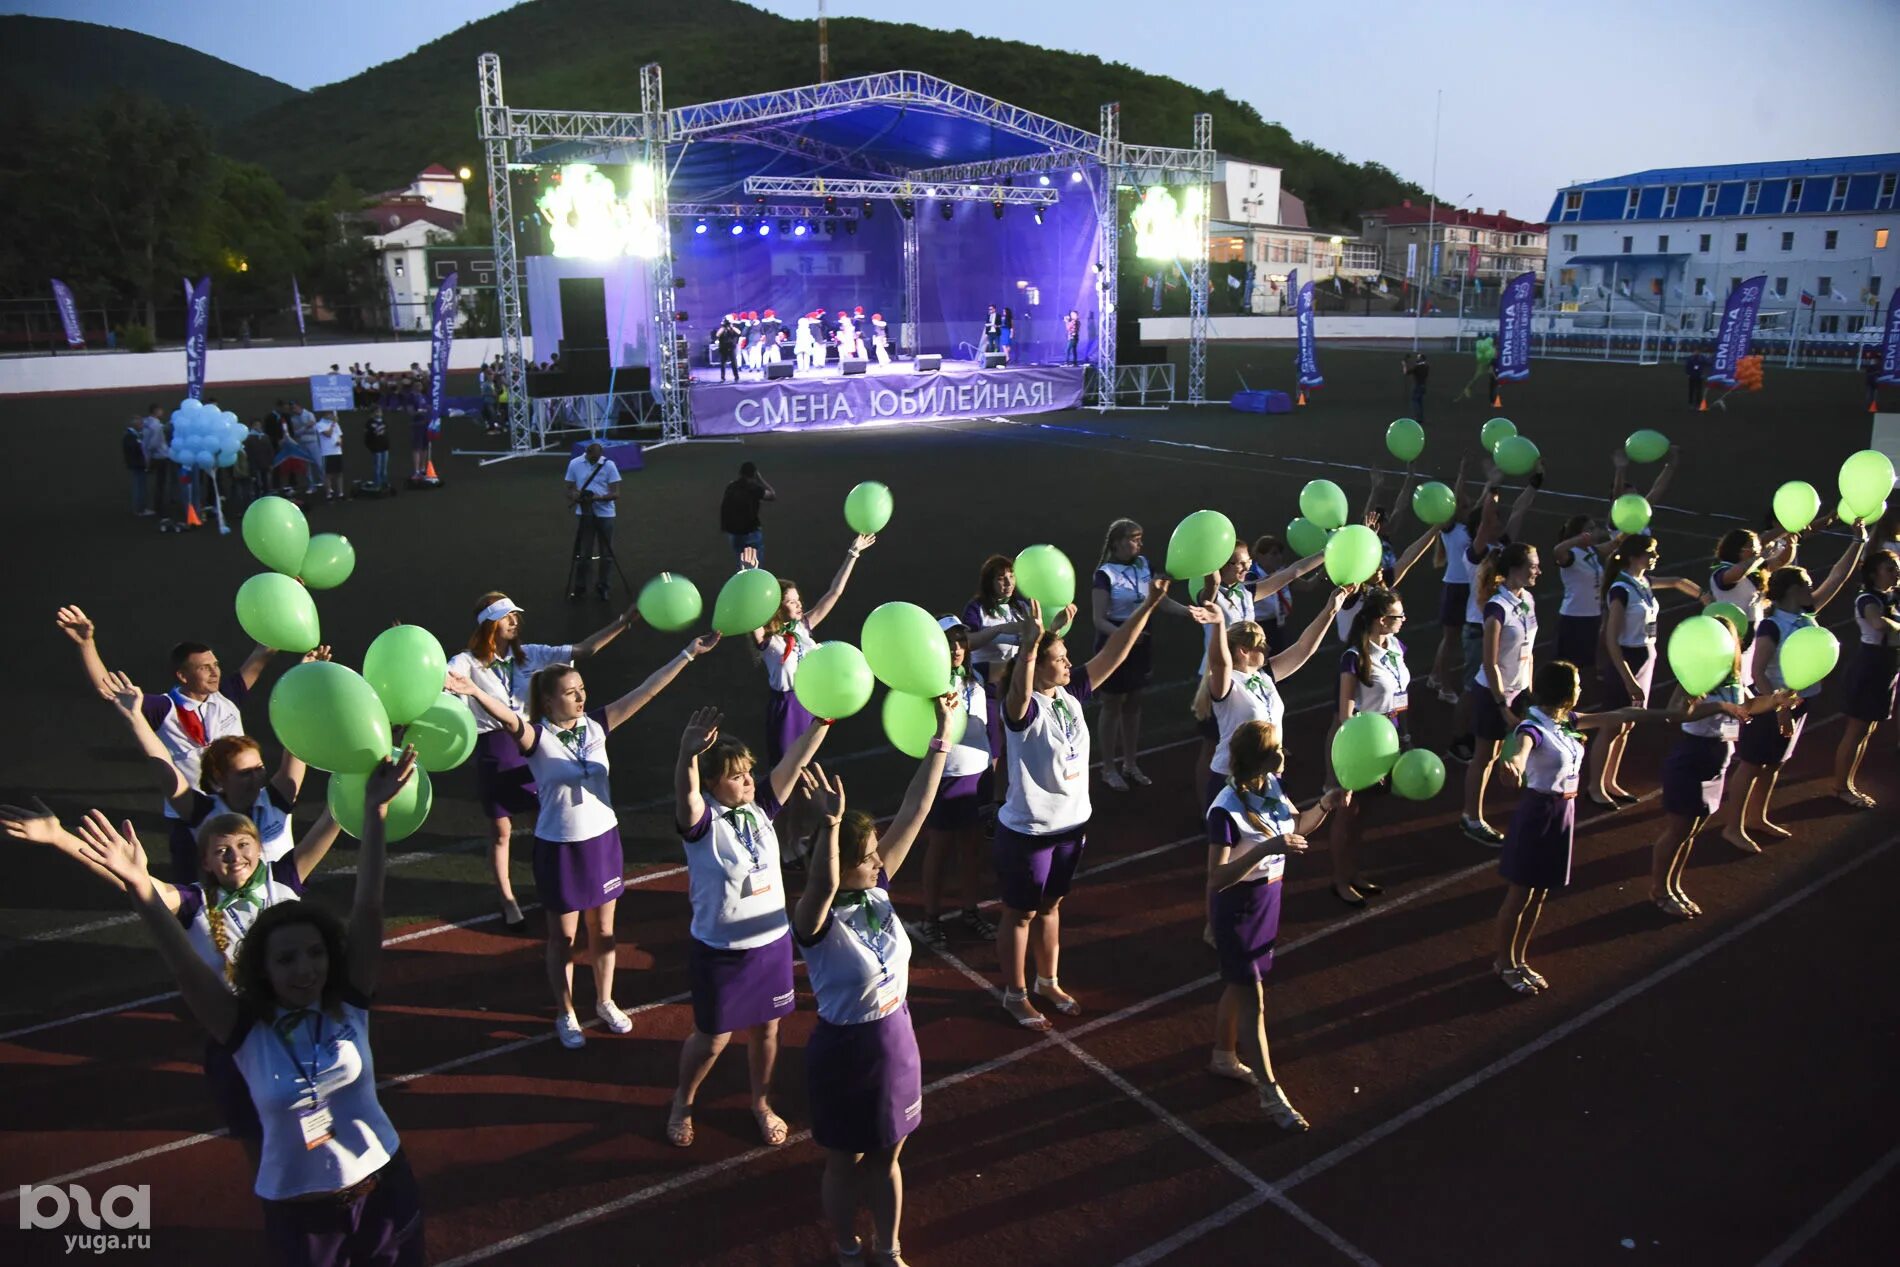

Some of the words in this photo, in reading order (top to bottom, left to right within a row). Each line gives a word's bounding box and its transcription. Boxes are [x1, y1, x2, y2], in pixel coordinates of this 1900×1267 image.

[1502, 304, 1516, 367] СМЕНА
[1715, 308, 1740, 370] СМЕНА
[735, 391, 854, 428] СМЕНА
[870, 379, 1053, 417] ЮБИЛЕЙНАЯ!
